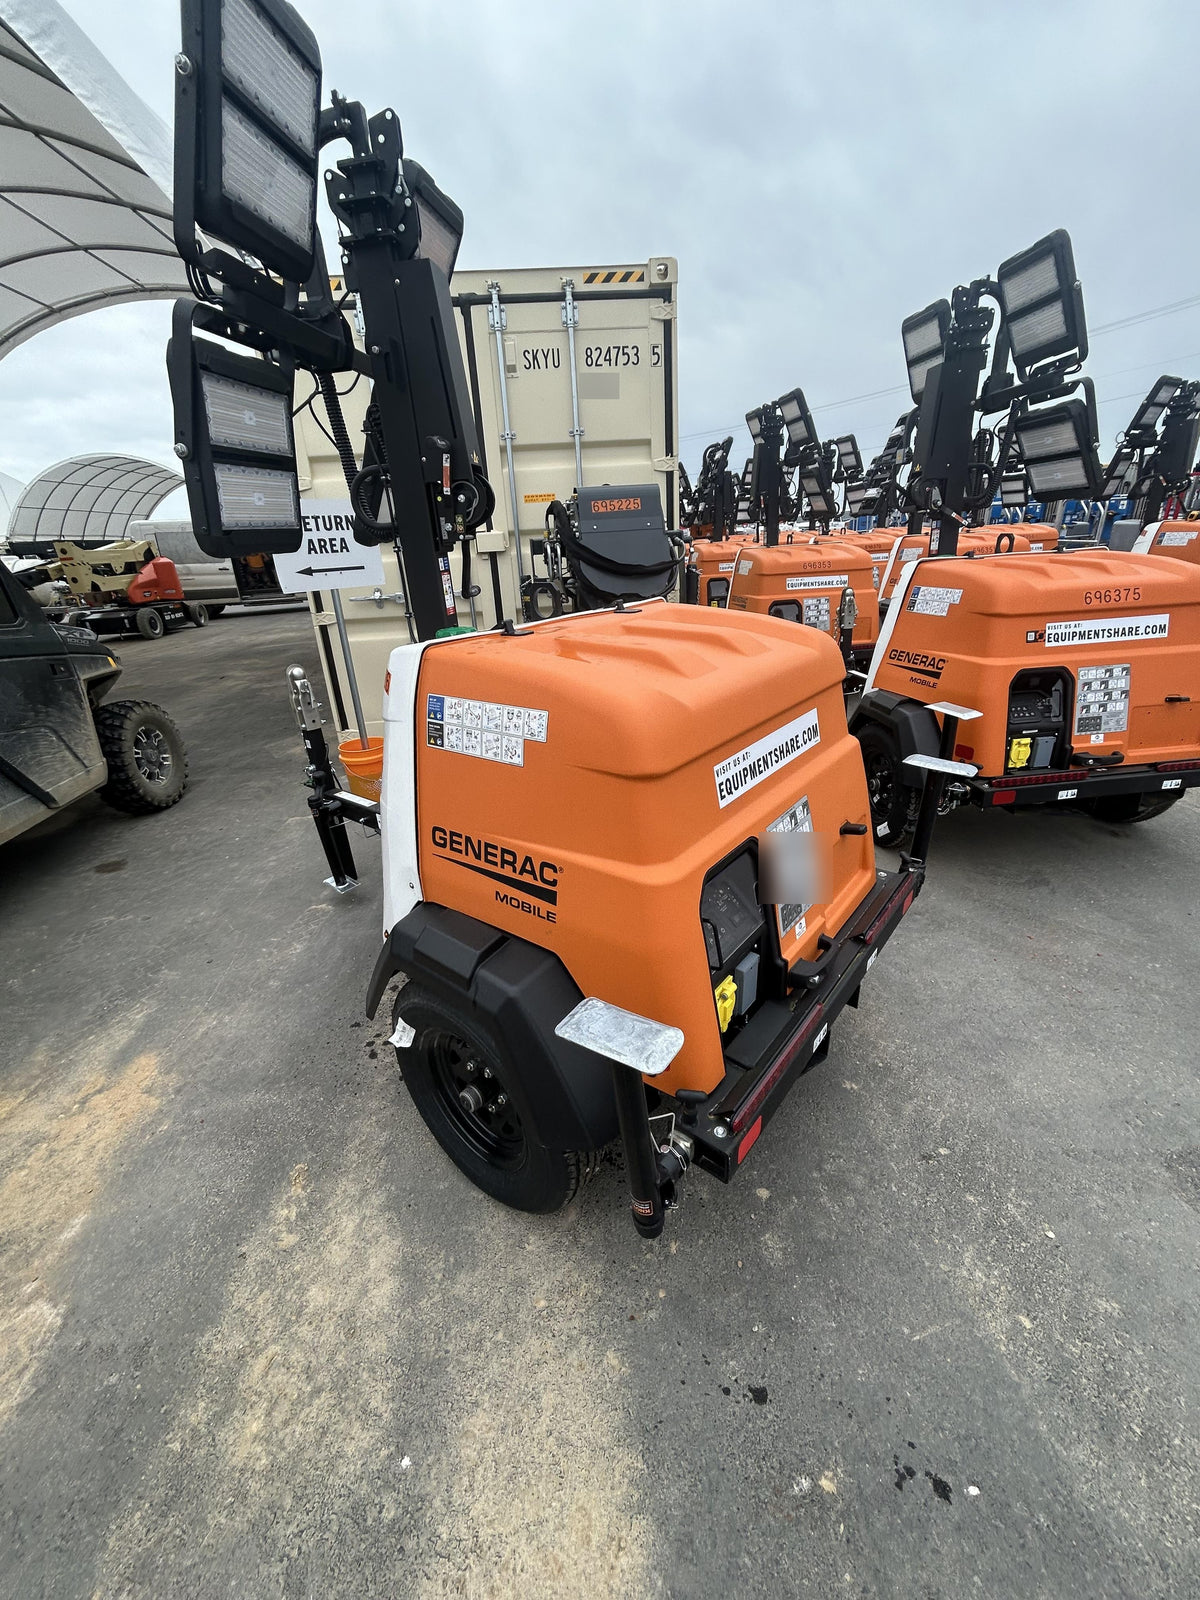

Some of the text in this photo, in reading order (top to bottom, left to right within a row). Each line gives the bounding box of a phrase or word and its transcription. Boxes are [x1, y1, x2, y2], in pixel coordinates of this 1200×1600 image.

[523, 345, 661, 370] SKYU 824753 5
[592, 498, 640, 512] 695225
[301, 514, 355, 532] ETURN
[307, 537, 350, 555] AREA
[802, 561, 832, 570] 696353
[787, 580, 848, 589] EQUIPMENTSHARE.COM
[1084, 587, 1141, 605] 696375
[1047, 624, 1167, 643] EQUIPMENTSHARE.COM
[889, 648, 946, 671] GENERAC
[909, 676, 938, 689] MOBILE
[716, 751, 751, 778] VISIT US AT:
[718, 723, 819, 801] EQUIPMENTSHARE.COM
[432, 825, 558, 887] GENERAC
[495, 890, 557, 924] MOBILE
